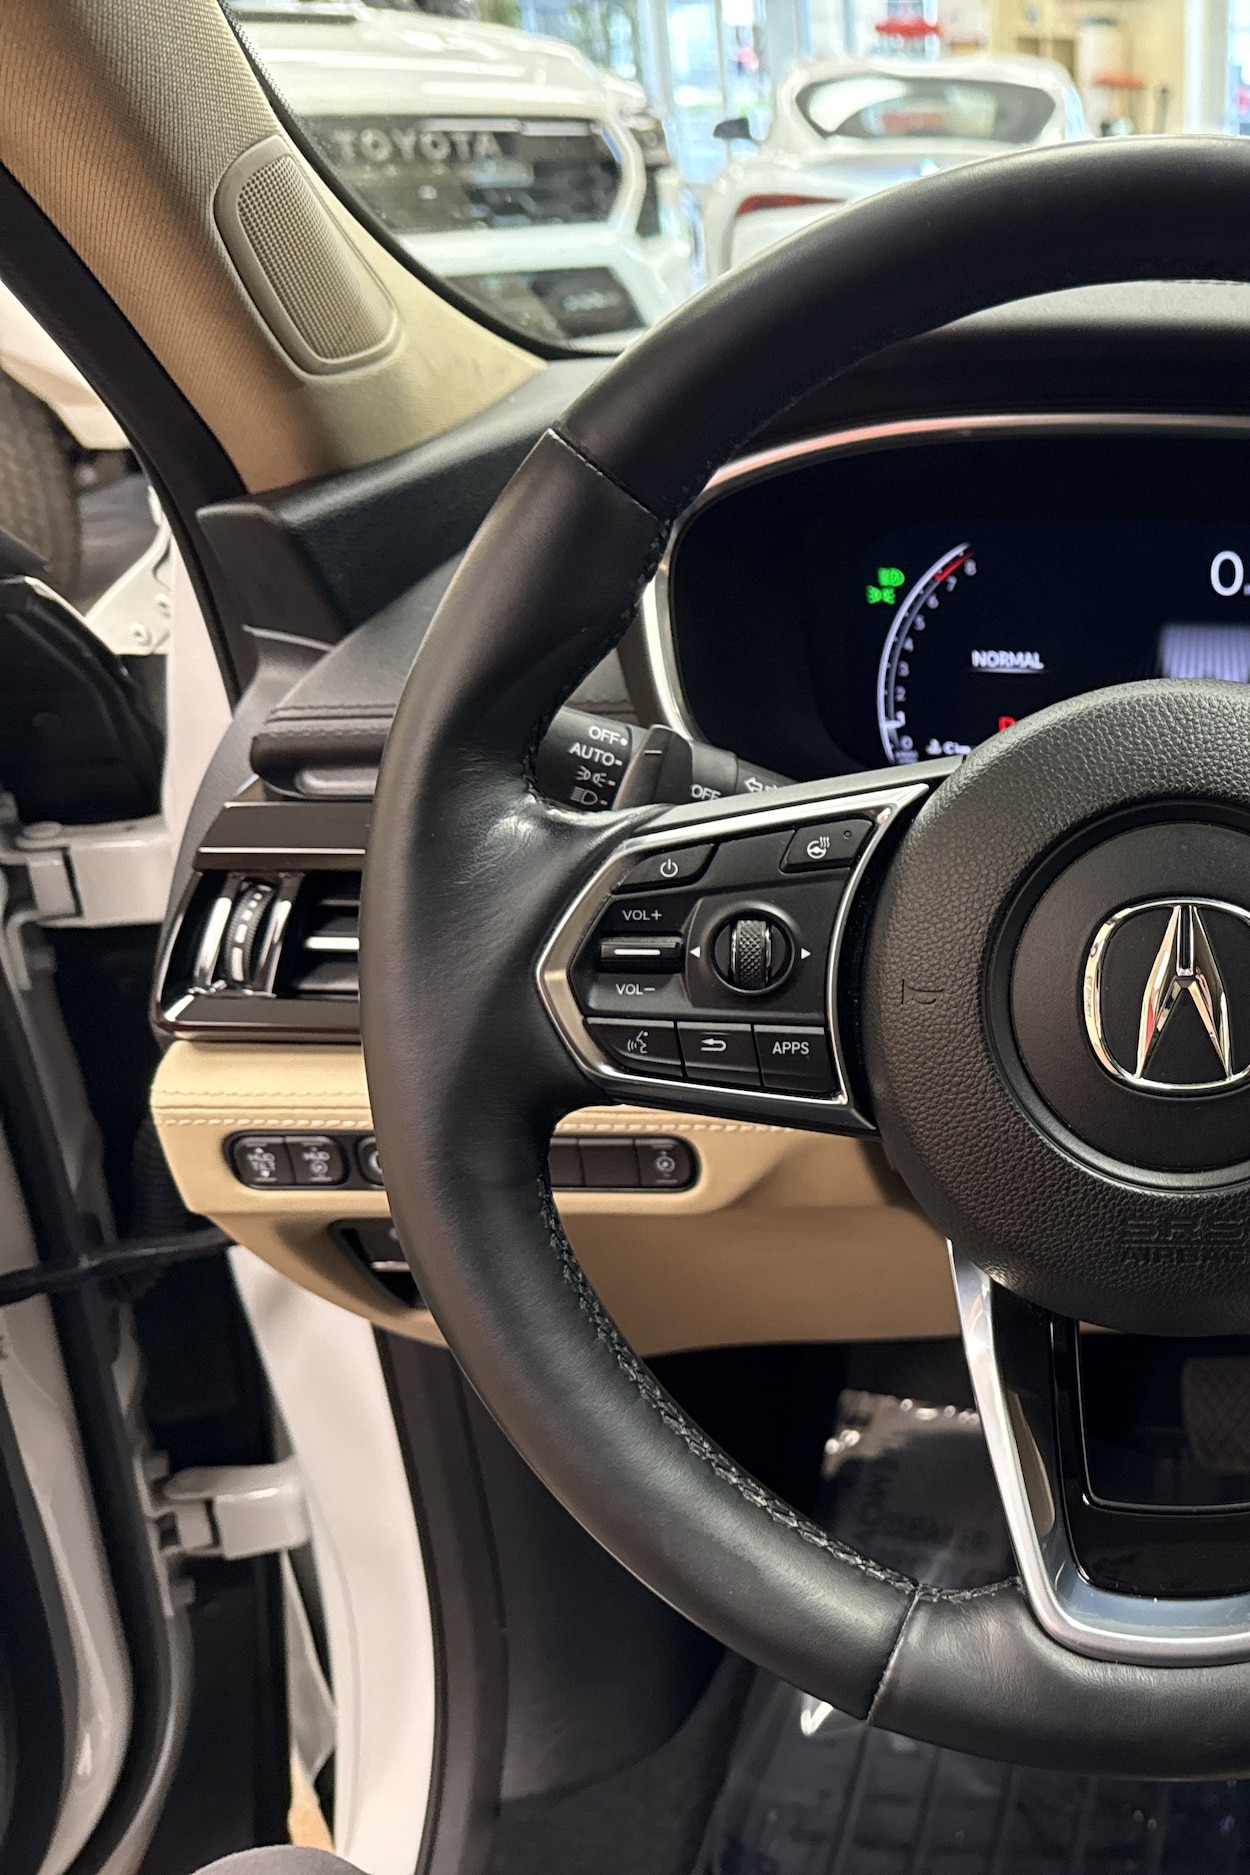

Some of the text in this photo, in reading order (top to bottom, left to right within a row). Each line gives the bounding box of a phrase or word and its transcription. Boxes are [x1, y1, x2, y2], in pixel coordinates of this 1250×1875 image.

[333, 127, 503, 163] TOYOTA
[1211, 551, 1244, 597] 0
[971, 650, 1045, 670] NORMAL
[589, 725, 621, 745] OFF
[569, 742, 616, 767] AUTO
[772, 1041, 810, 1056] APPS
